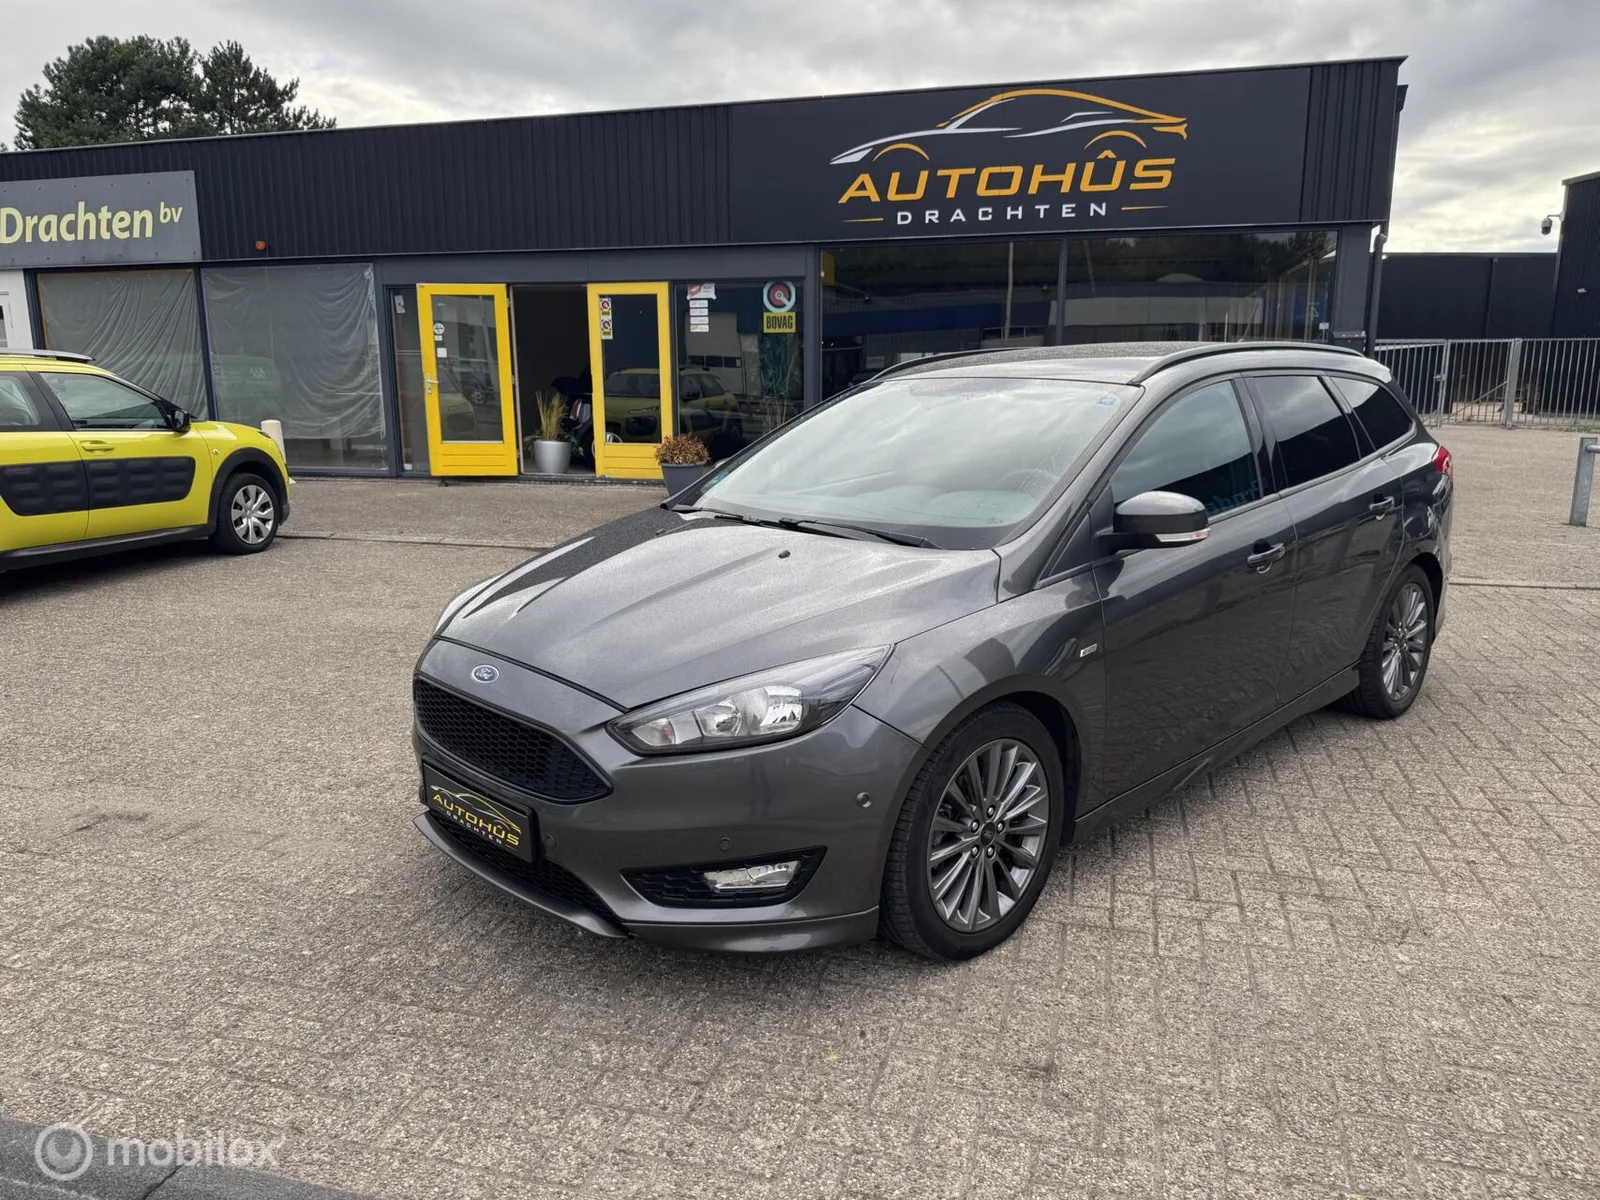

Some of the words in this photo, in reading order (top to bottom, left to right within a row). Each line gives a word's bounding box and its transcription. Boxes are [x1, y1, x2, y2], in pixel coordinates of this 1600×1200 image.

[838, 150, 1176, 203] AUTOHÛS
[0, 201, 153, 244] Drachten
[159, 201, 183, 224] bv
[896, 202, 1107, 225] DRACHTEN
[766, 315, 793, 329] BOVAG
